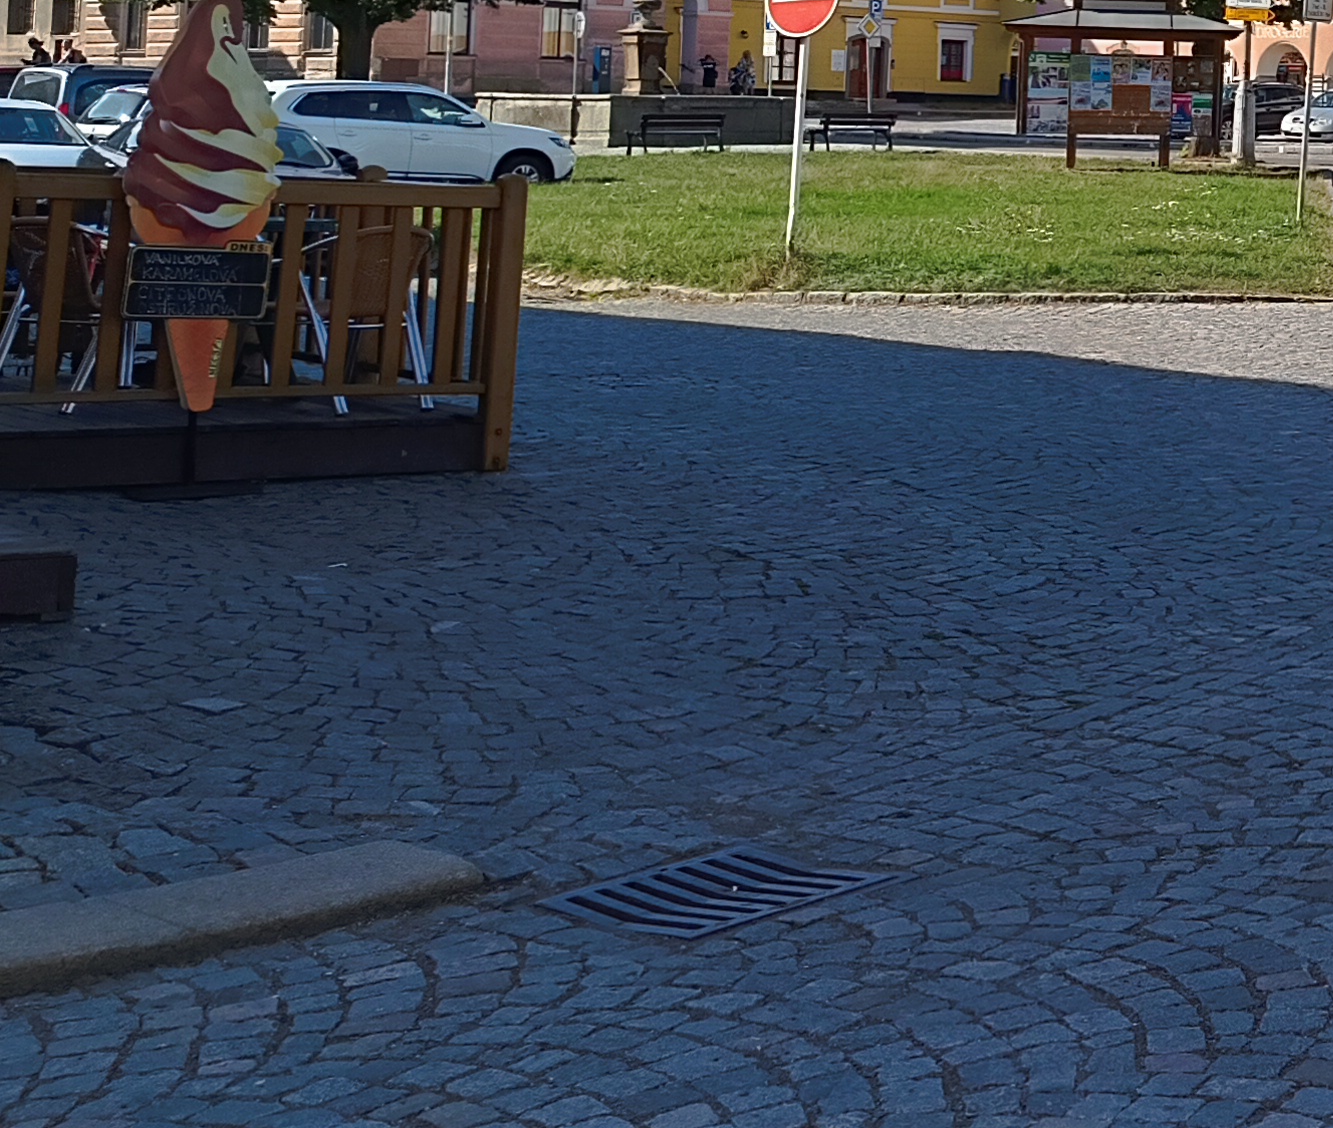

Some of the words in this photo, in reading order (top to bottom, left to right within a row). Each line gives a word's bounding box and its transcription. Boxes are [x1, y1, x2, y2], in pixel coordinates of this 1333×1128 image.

[871, 0, 880, 12] P
[230, 243, 268, 252] DNES:
[144, 252, 222, 266] VANILKOVÁ
[142, 265, 240, 282] KARAMELOVÁ
